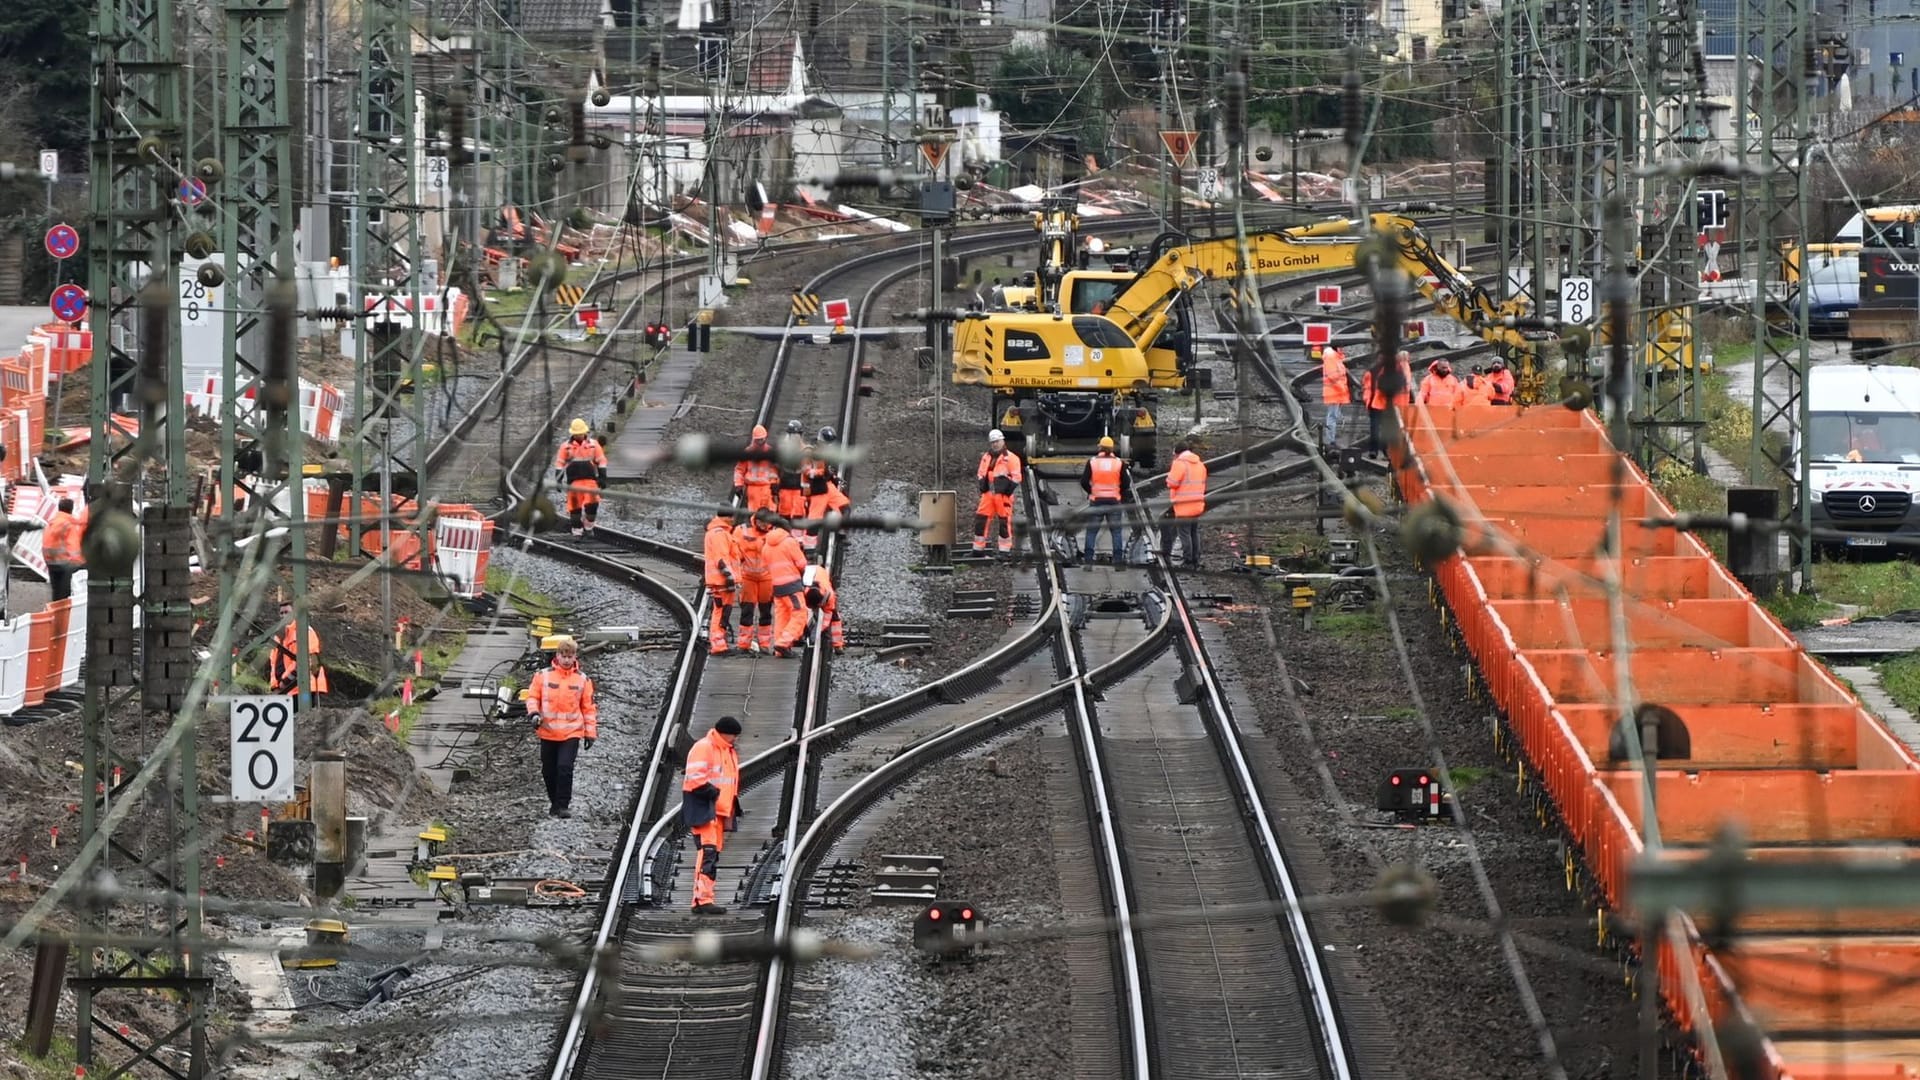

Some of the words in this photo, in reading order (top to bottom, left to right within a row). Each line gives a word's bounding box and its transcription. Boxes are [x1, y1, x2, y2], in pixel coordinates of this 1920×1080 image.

[927, 108, 942, 127] 14
[1175, 138, 1184, 154] 9
[430, 159, 446, 172] 28
[1199, 170, 1215, 183] 28
[1259, 258, 1281, 269] Bau
[1283, 254, 1319, 265] GmbH
[181, 279, 205, 299] 28
[1565, 282, 1590, 301] 28
[187, 301, 199, 320] 8
[1571, 304, 1582, 323] 8
[1007, 339, 1034, 348] 922
[1092, 352, 1101, 360] 20
[1048, 377, 1072, 385] GmbH
[236, 703, 290, 743] 29
[248, 750, 278, 790] 0
